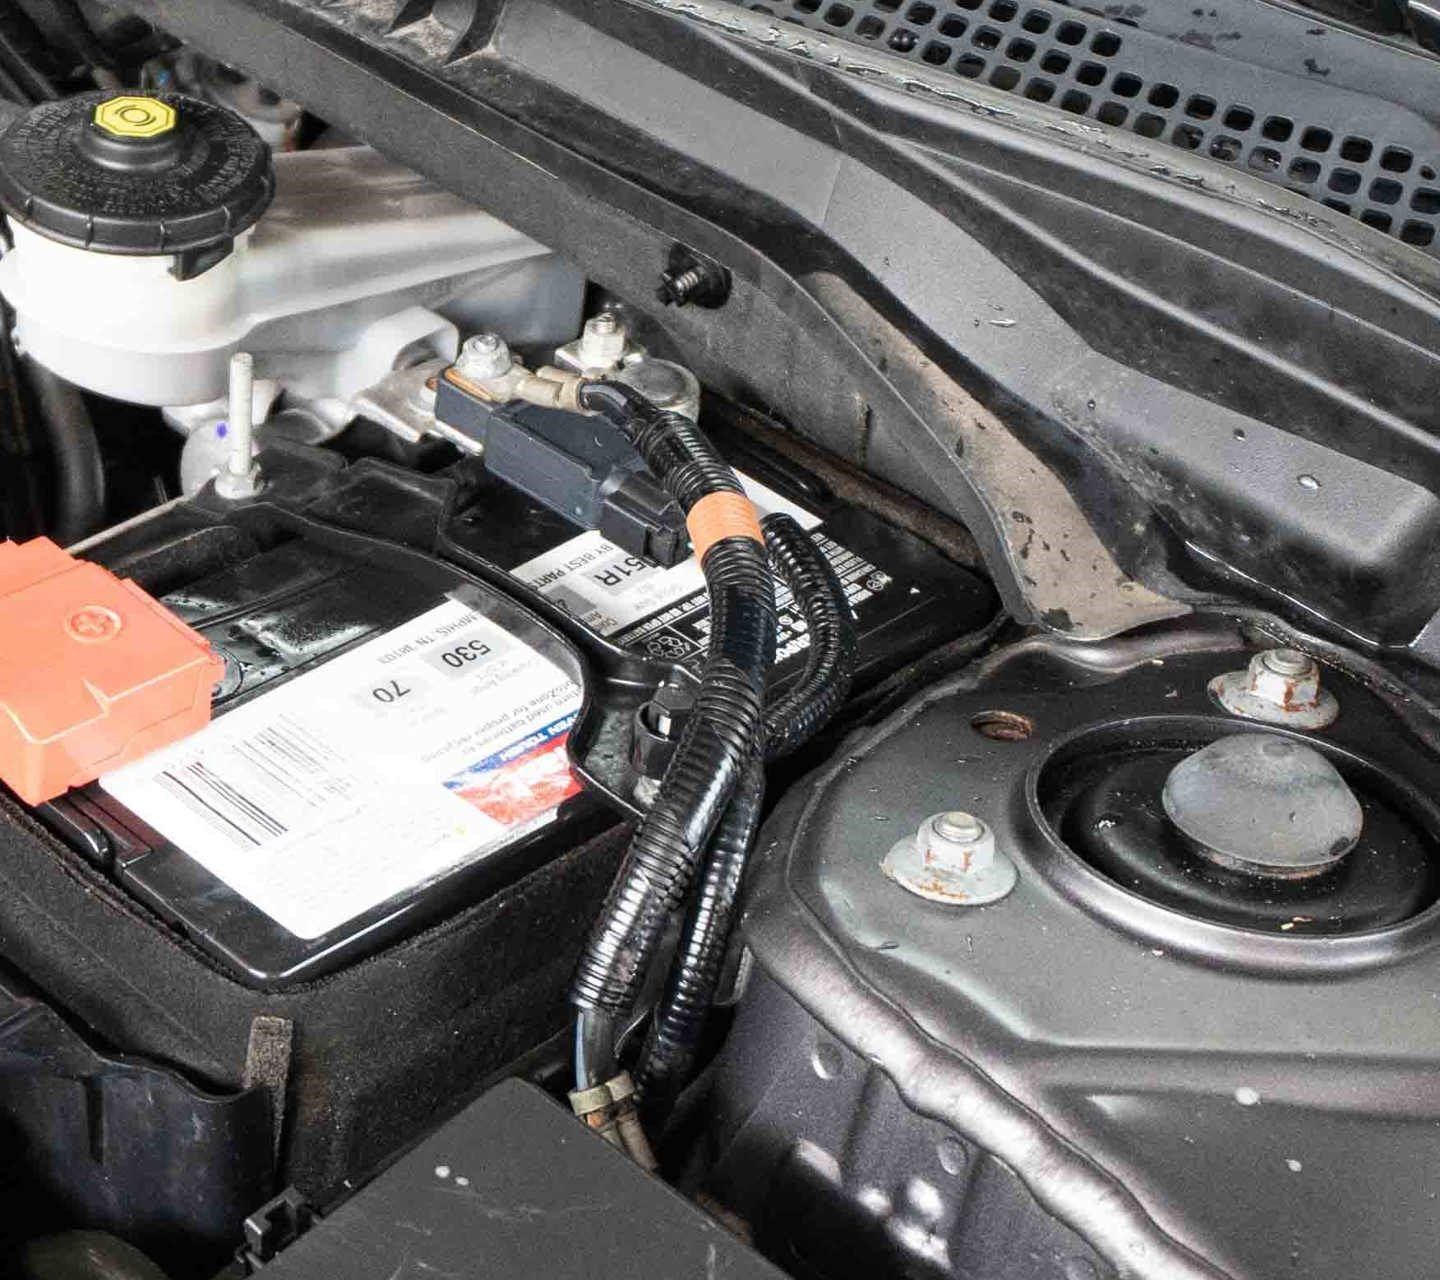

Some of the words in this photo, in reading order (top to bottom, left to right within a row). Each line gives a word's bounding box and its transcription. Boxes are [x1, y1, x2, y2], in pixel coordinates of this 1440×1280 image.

[568, 551, 599, 572] BEST
[593, 556, 648, 588] 51R
[441, 639, 492, 669] 530
[372, 679, 411, 704] 70
